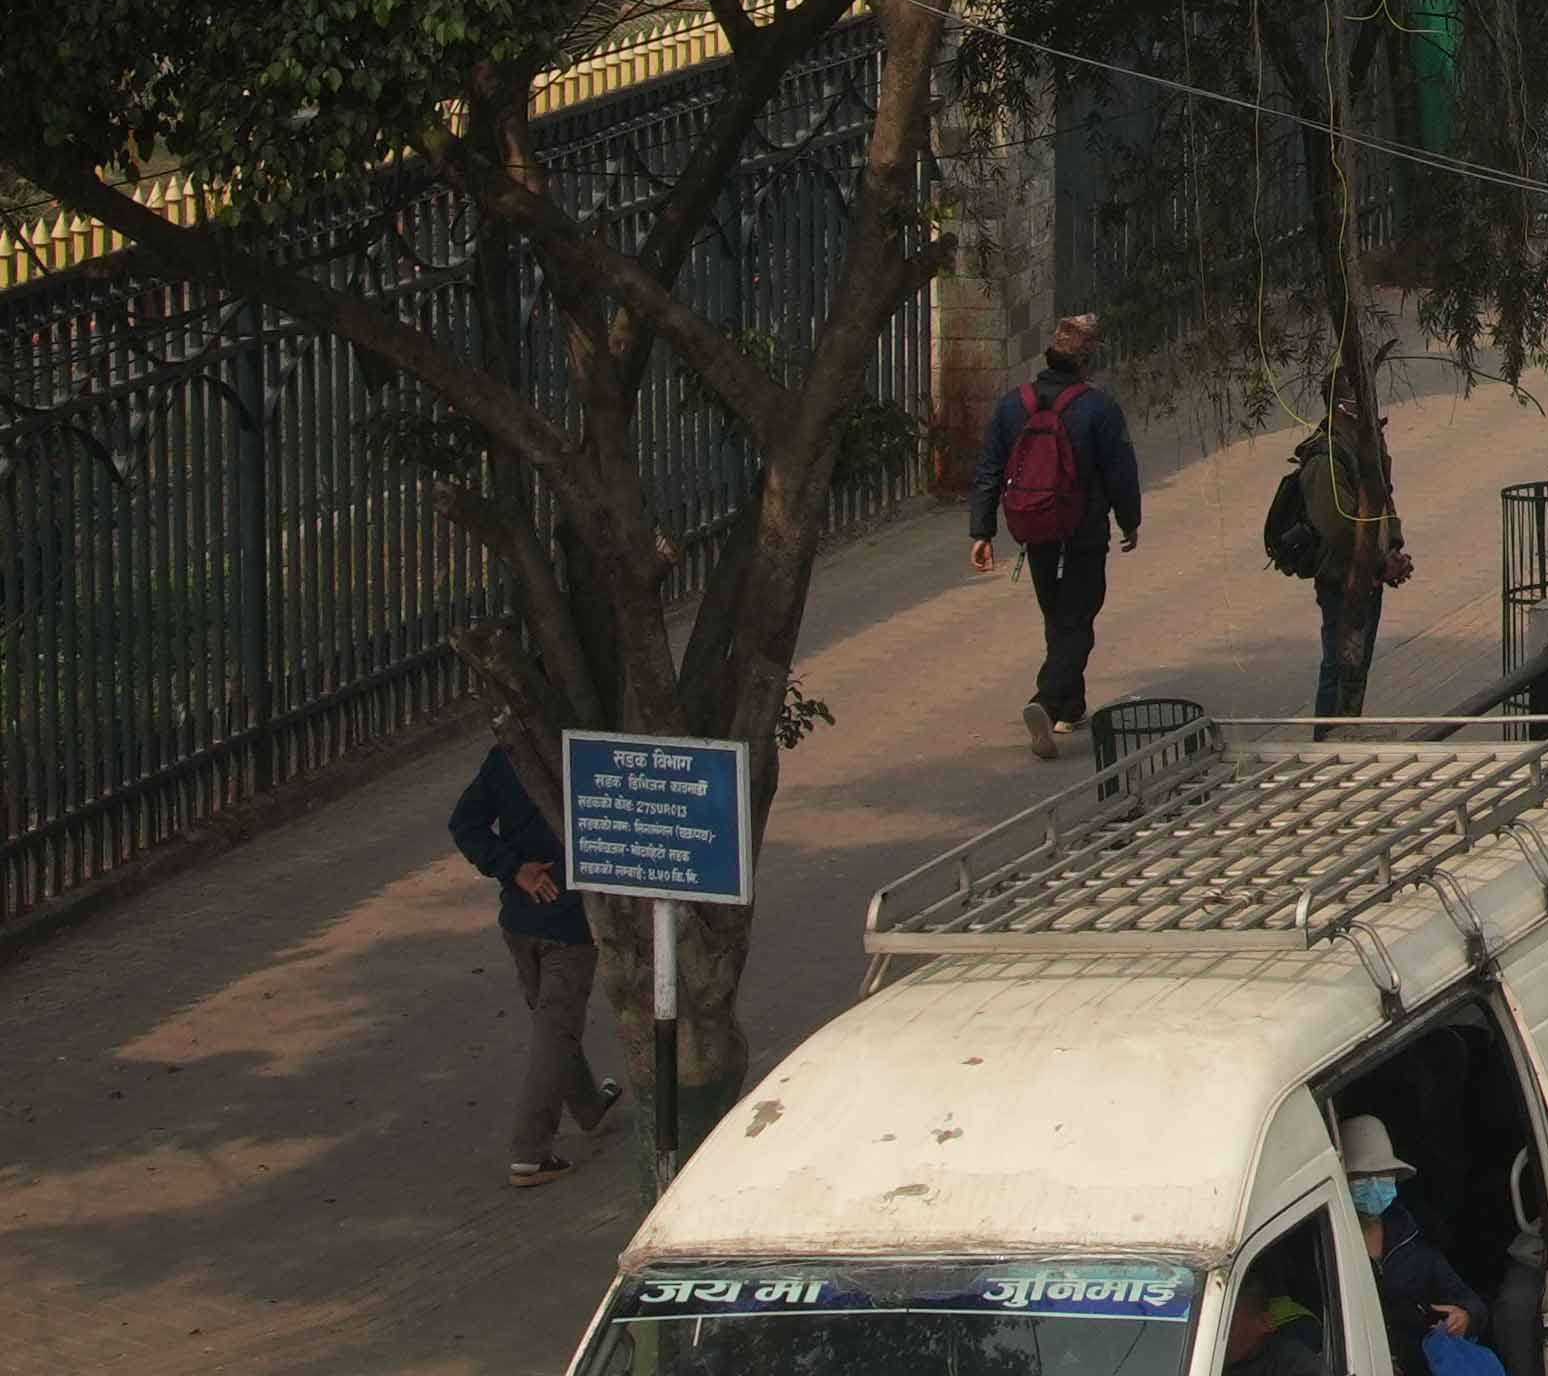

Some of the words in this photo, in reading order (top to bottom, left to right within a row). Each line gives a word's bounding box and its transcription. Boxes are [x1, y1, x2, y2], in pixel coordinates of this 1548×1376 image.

[613, 749, 648, 769] सडक
[652, 748, 693, 772] विभाग
[639, 1278, 749, 1304] जय
[980, 1271, 1185, 1308] जुनिमाई
